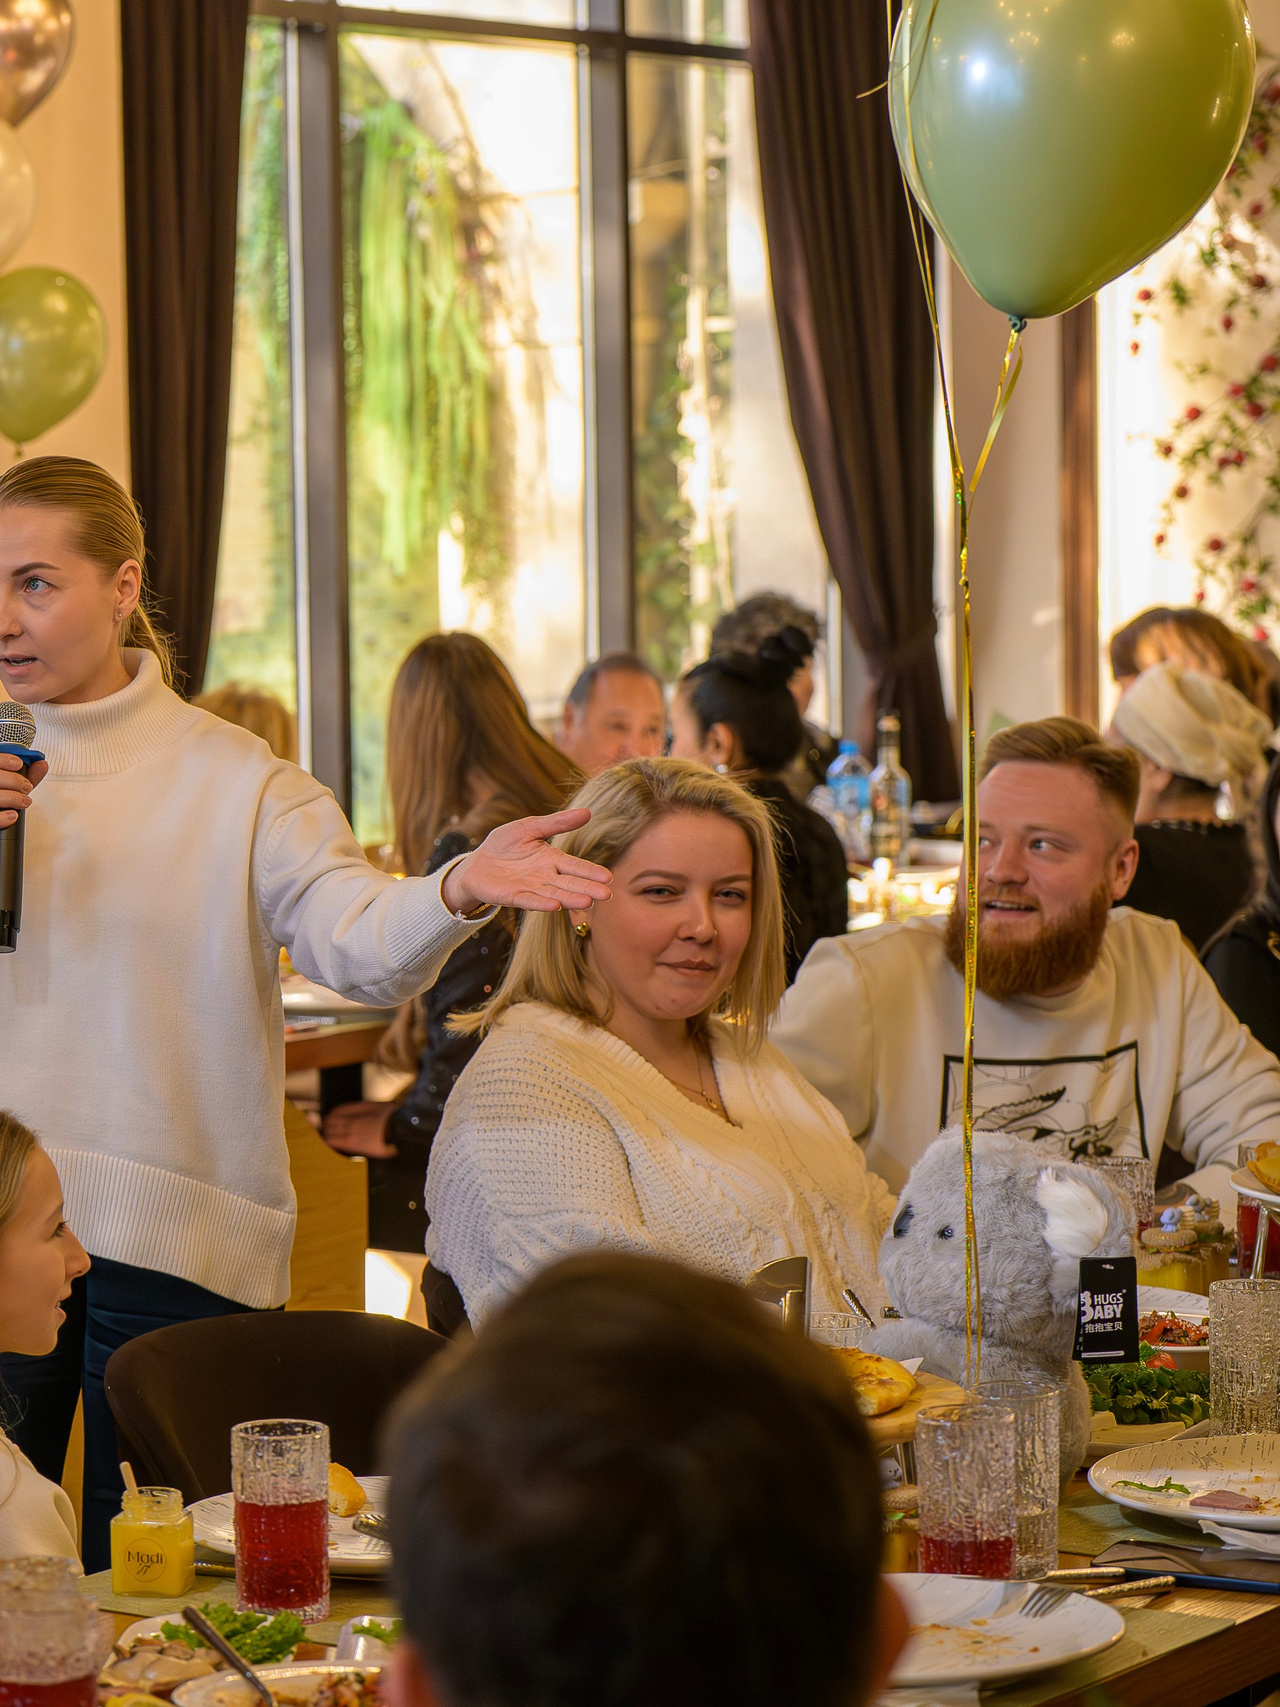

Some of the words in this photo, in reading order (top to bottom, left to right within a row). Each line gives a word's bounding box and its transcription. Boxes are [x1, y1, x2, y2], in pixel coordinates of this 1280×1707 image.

[1094, 1292, 1124, 1305] HUGS
[1085, 1321, 1123, 1333] 抱抱宝贝
[127, 1550, 163, 1565] Madi
